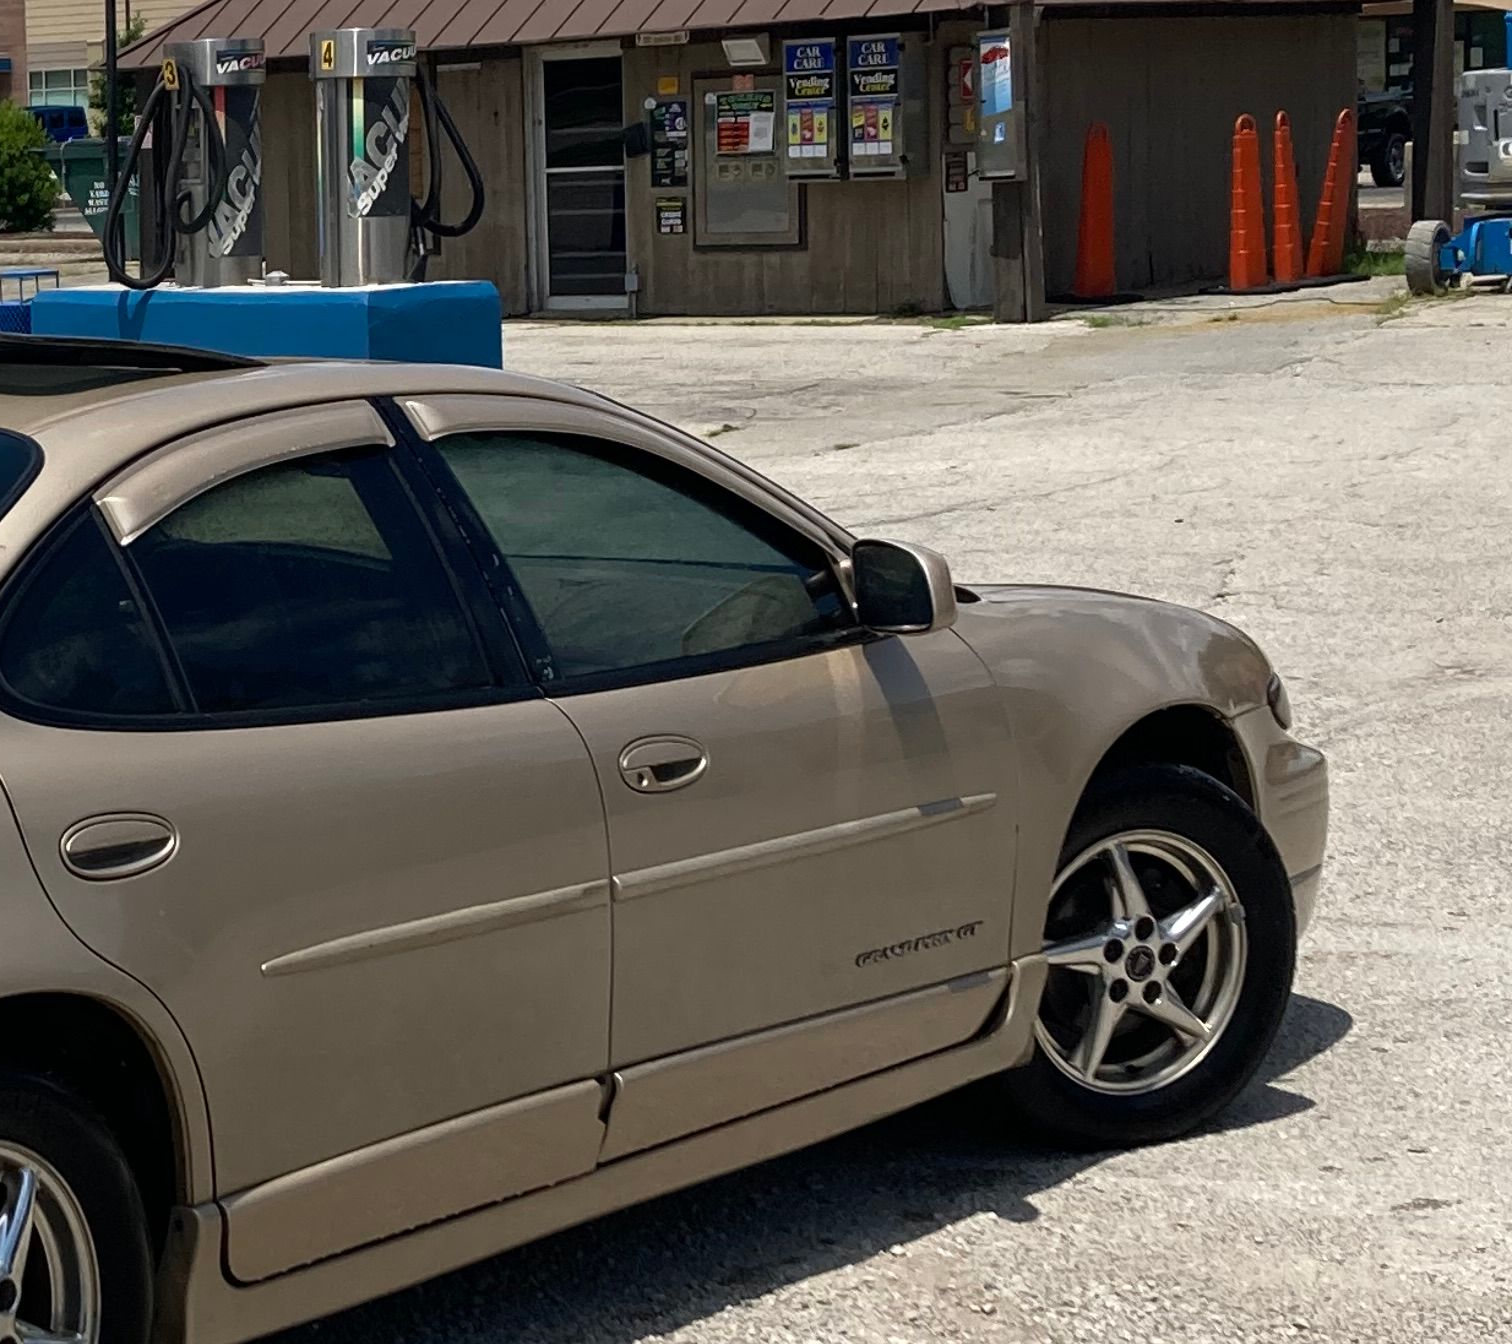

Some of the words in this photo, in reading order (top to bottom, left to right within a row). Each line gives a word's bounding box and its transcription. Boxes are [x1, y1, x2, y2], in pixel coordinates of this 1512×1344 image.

[323, 41, 333, 68] 4
[367, 45, 416, 65] VACUU
[796, 46, 821, 58] CAR
[861, 41, 886, 54] CAR
[163, 61, 176, 85] 3
